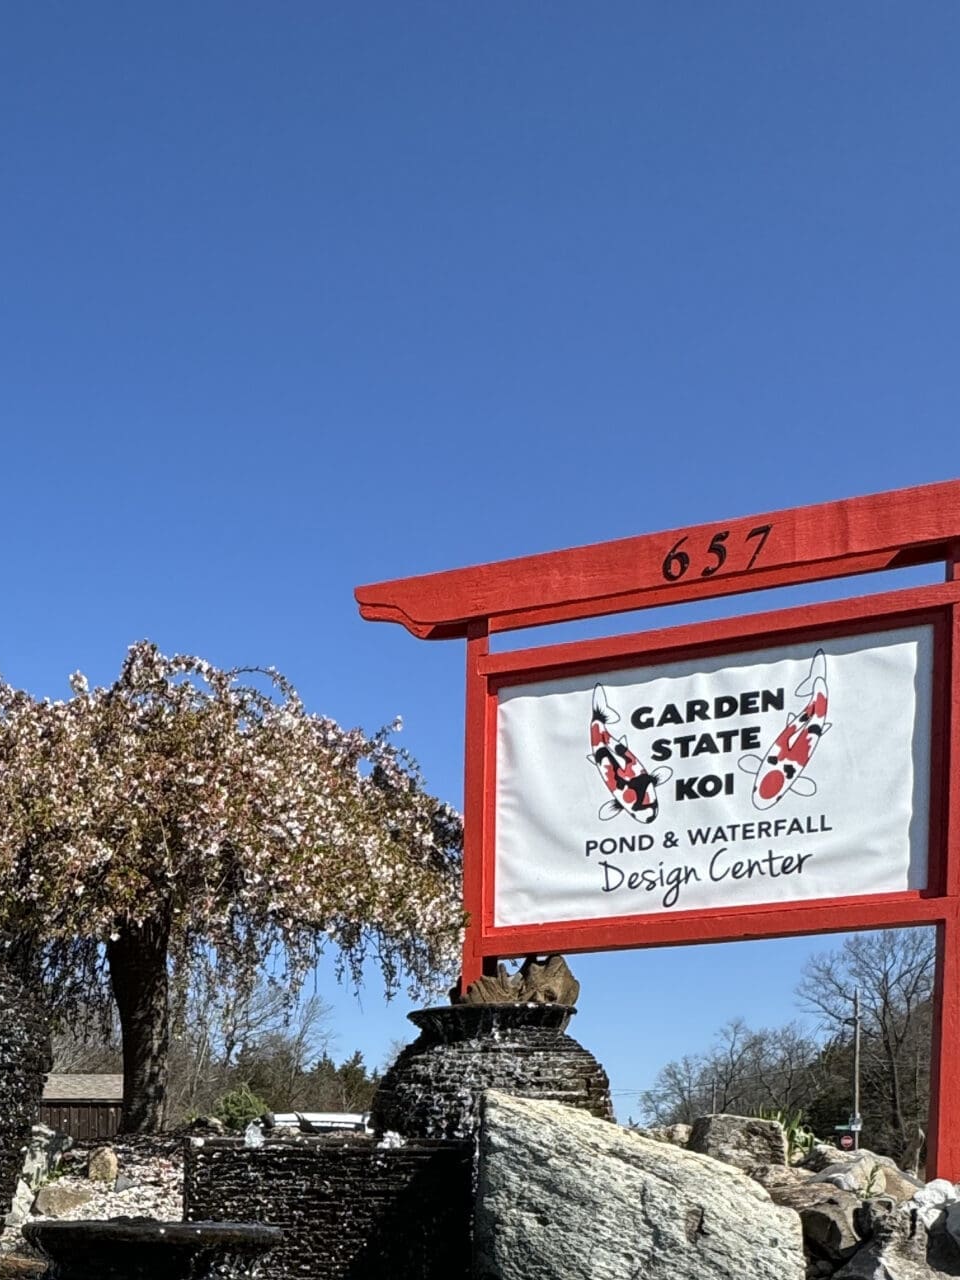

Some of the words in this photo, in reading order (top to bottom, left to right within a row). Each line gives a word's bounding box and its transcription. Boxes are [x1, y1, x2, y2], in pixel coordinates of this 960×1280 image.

[662, 523, 773, 581] 657
[631, 688, 784, 730] GARDEN
[651, 727, 761, 761] STATE
[675, 773, 734, 801] KOI
[586, 834, 654, 856] POND
[662, 831, 679, 848] &
[688, 815, 832, 845] WATERFALL
[598, 861, 701, 907] Design
[709, 848, 813, 882] Center
